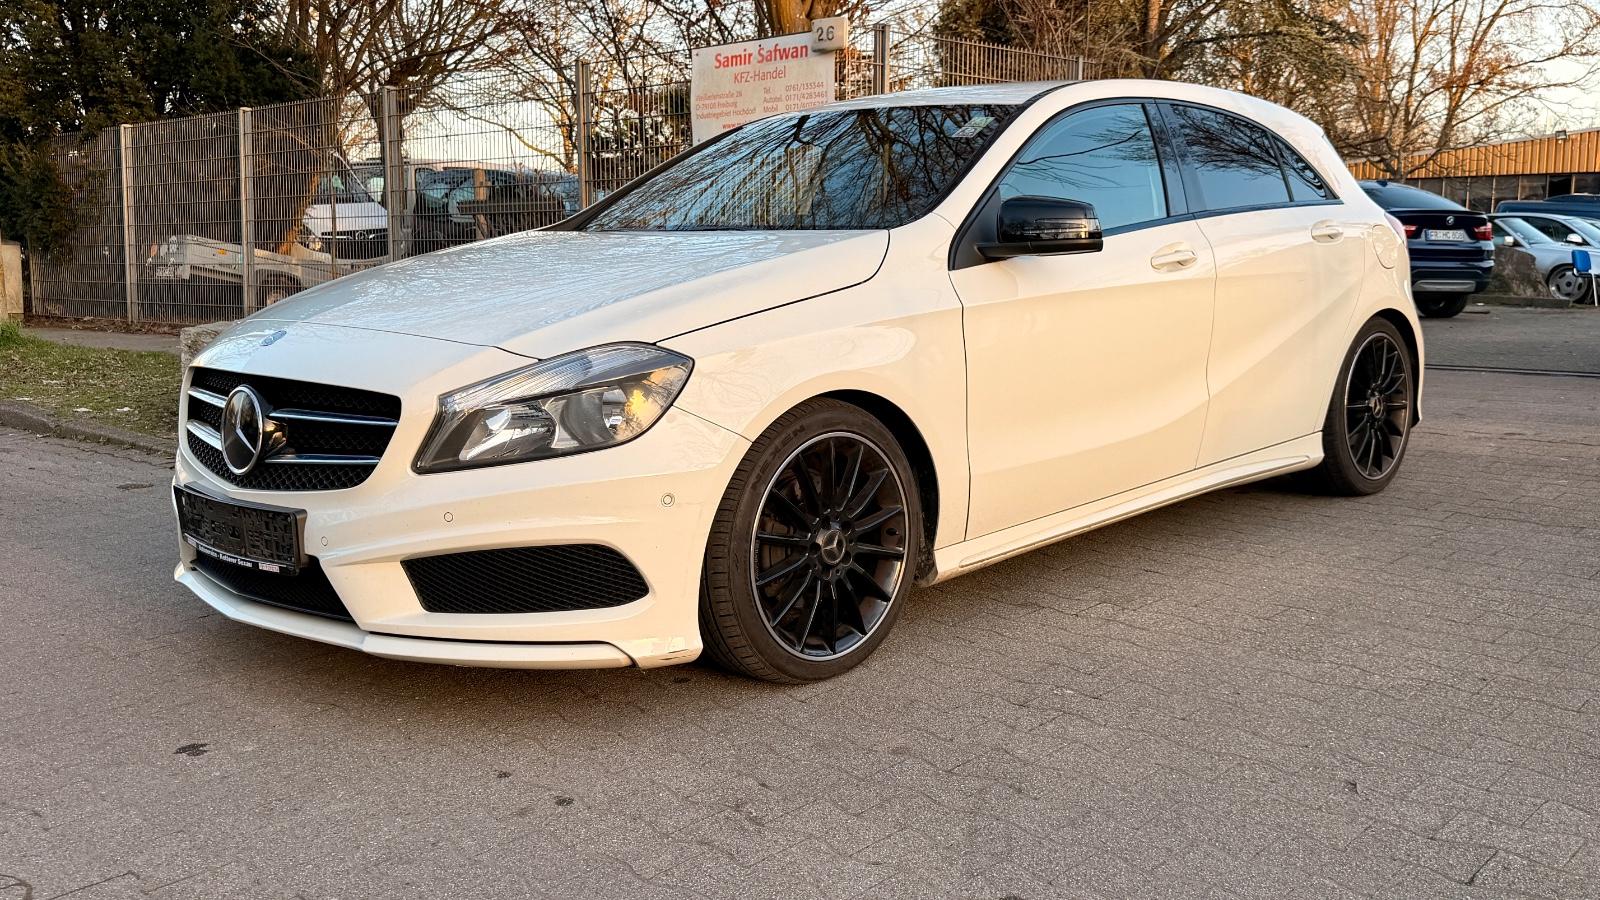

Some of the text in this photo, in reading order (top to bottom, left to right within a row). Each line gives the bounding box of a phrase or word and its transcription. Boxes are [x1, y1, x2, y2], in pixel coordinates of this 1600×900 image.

[714, 44, 808, 69] Samir Safwan
[733, 66, 786, 84] KFZ-Handel
